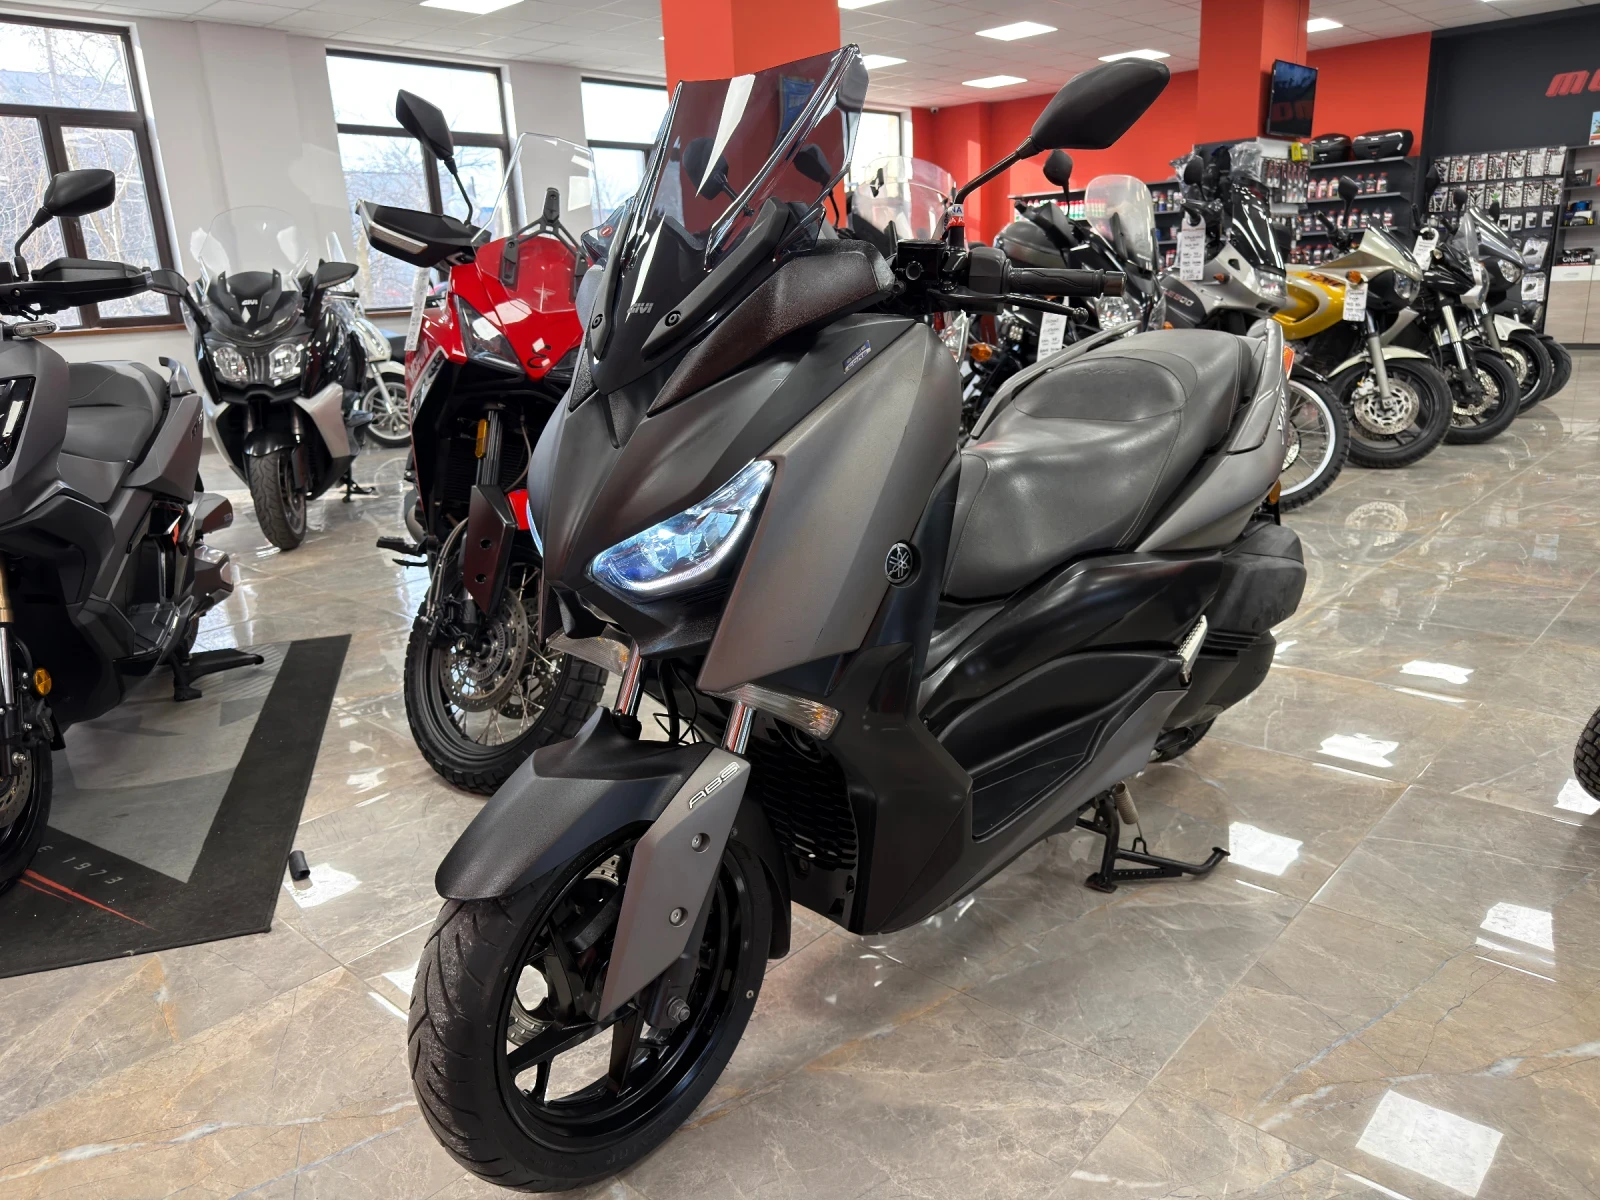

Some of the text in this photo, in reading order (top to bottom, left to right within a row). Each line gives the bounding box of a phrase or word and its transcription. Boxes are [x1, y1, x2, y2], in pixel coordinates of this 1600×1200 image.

[626, 302, 654, 314] GIVI
[689, 761, 741, 809] ABS
[62, 856, 124, 885] 1973
